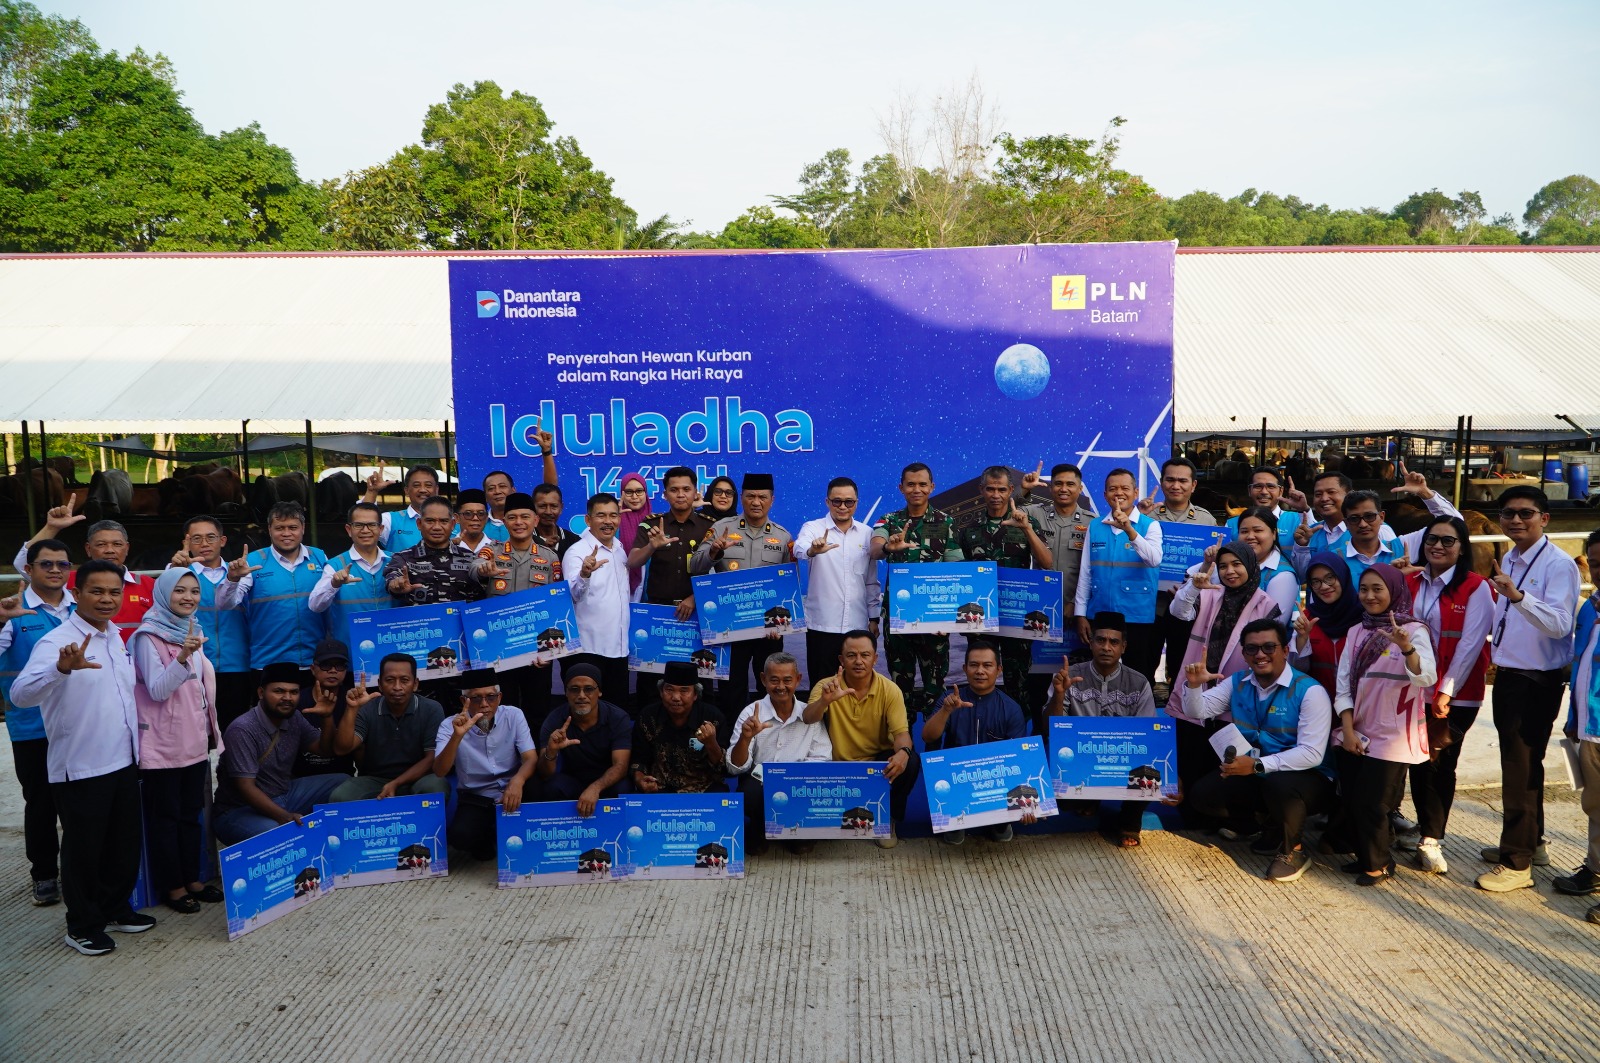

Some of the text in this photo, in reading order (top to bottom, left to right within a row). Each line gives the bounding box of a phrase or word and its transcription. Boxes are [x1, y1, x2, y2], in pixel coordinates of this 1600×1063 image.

[504, 289, 580, 302] Danantara
[1091, 281, 1146, 301] PLN
[504, 304, 576, 318] Indonesia
[1091, 310, 1138, 323] Batam
[548, 349, 752, 368] Penyerahan Hewan Kurban
[556, 367, 743, 384] dalam Rangka Hari Raya
[489, 396, 814, 458] Iduladha
[718, 588, 777, 605] Iduladha
[913, 583, 973, 595] Iduladha
[998, 587, 1039, 602] uladha
[488, 610, 550, 632] Iduladha
[377, 627, 443, 644] Iduladha
[651, 625, 700, 640] Iduladh
[1077, 741, 1148, 754] Iduladha
[951, 764, 1021, 784] Iduladha
[792, 785, 861, 798] Iduladha
[344, 822, 417, 841] Iduladha
[526, 826, 598, 841] Iduladha
[647, 818, 715, 833] Iduladha
[248, 848, 307, 881] Iduladha
